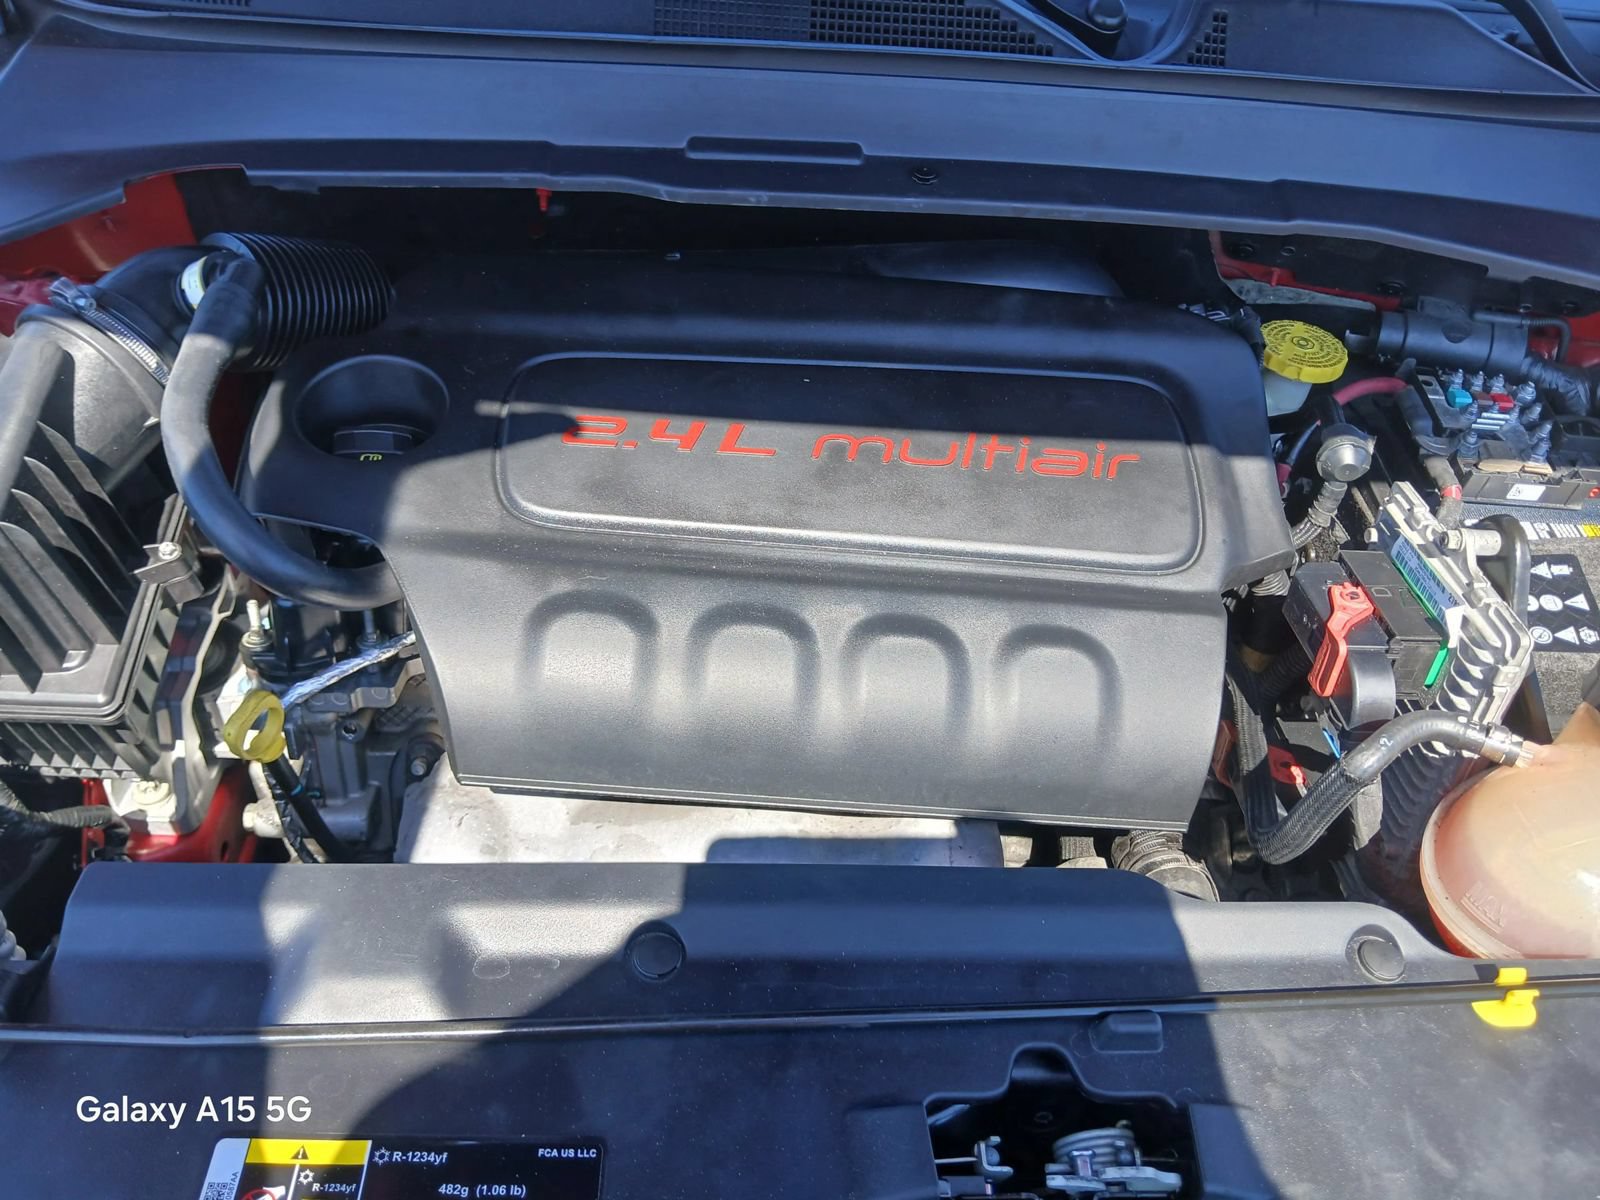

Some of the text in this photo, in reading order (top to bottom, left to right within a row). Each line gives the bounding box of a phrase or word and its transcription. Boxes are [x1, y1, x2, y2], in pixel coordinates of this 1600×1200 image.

[810, 432, 1142, 480] multiair
[392, 1151, 448, 1164] R-1234yf
[538, 1148, 597, 1158] FCA US LLC
[311, 1182, 356, 1193] R-1234yf
[438, 1183, 527, 1198] 482g (1.06 lb)
